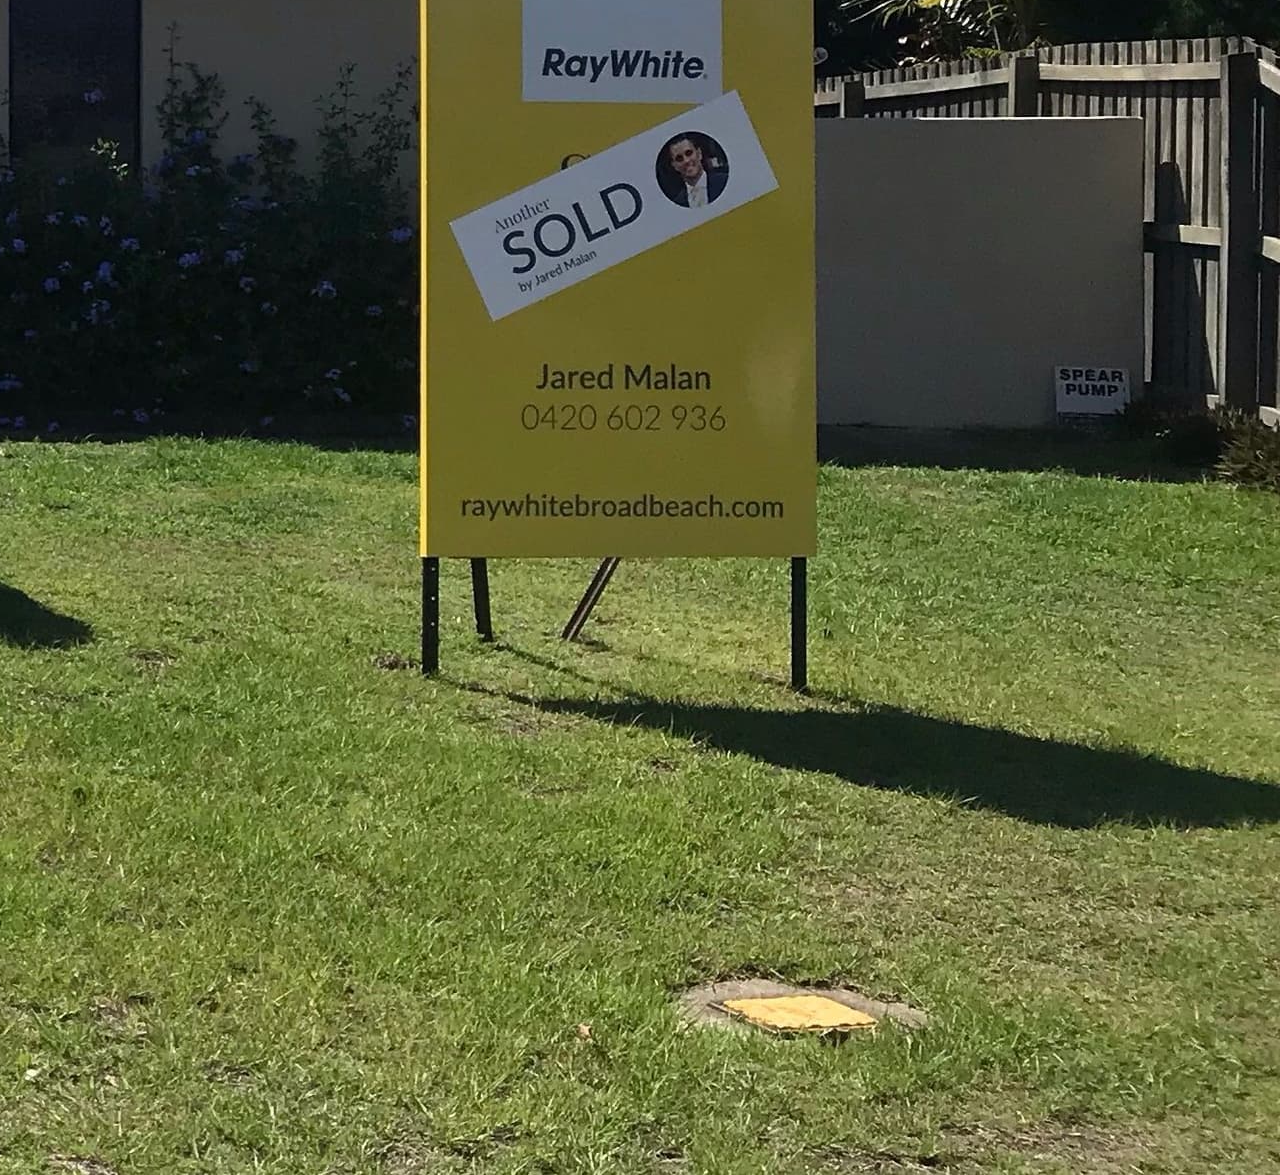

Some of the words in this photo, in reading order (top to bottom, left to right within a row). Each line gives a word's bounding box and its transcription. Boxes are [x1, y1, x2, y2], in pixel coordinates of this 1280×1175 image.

[495, 199, 550, 233] Another
[503, 183, 643, 274] SOLD
[518, 280, 532, 292] by
[535, 264, 563, 286] Jared
[563, 250, 597, 271] Malan
[536, 363, 613, 390] Jared
[624, 363, 711, 390] Malan
[1059, 368, 1124, 382] SPEAR
[1065, 383, 1119, 396] PUMP
[521, 404, 597, 431] 0420
[606, 404, 661, 431] 602
[671, 405, 727, 431] 936
[460, 493, 784, 522] raywhitebroadbeach.com
